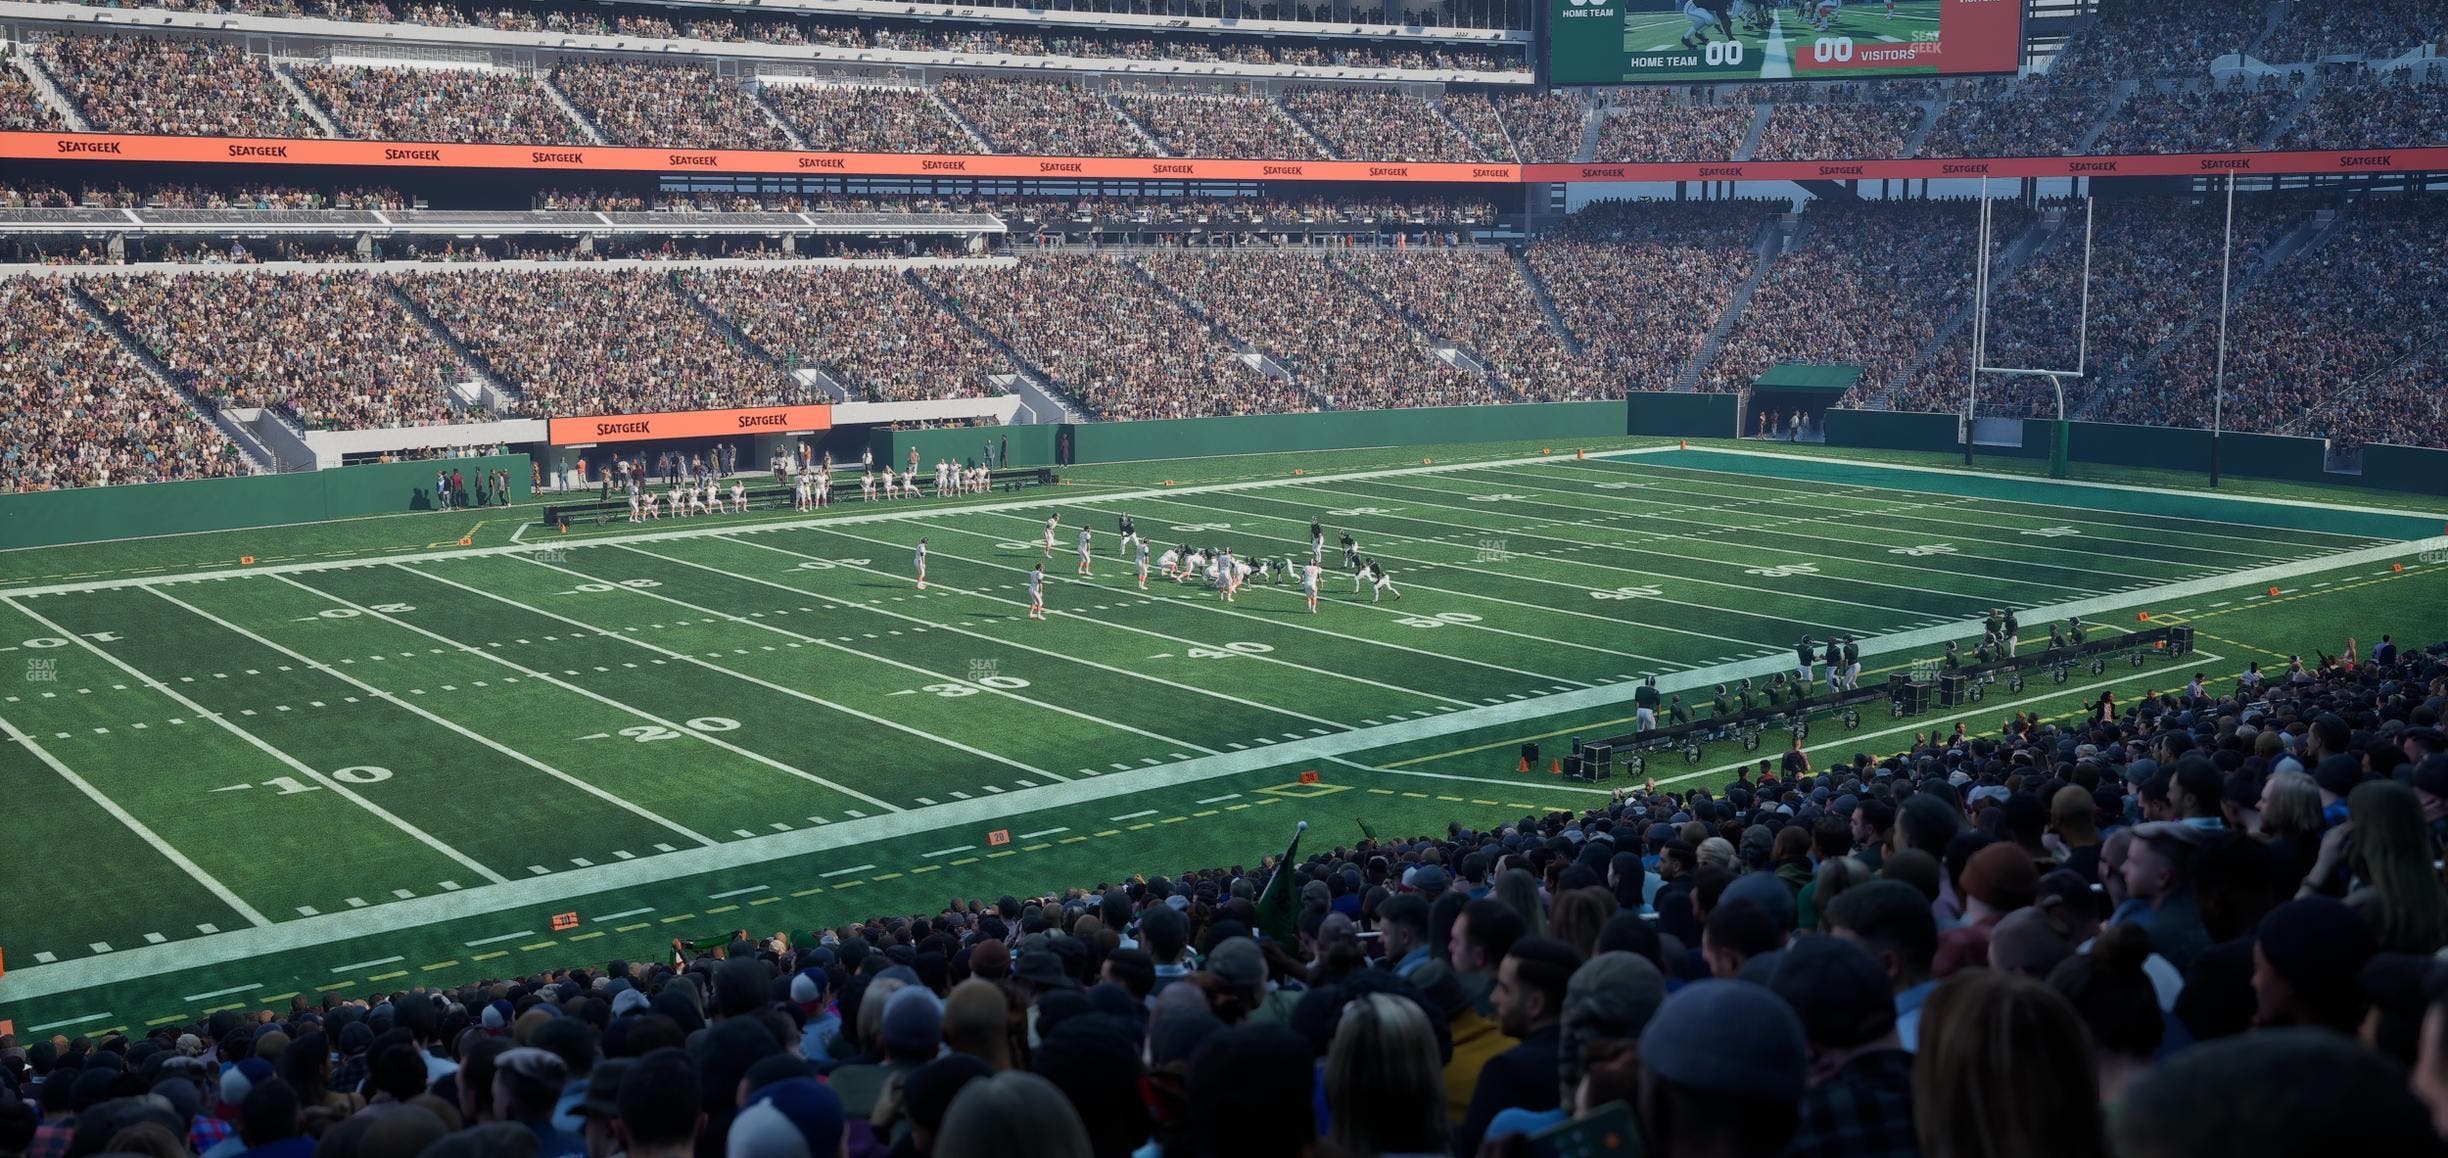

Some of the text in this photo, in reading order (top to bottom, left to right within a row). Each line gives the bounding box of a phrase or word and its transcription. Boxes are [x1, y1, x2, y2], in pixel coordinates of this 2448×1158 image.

[1562, 8, 1614, 18] HOME TEAM
[1705, 40, 1744, 66] 00
[1814, 37, 1853, 63] 00
[1860, 49, 1916, 62] VISITORS
[1631, 56, 1698, 68] HOME TEAM
[58, 140, 121, 154] SEATGEEK
[228, 144, 288, 158] SEATGEEK
[385, 148, 441, 161] SEATGEEK
[532, 152, 584, 164] SEATGEEK
[669, 154, 718, 167] SEATGEEK
[798, 157, 845, 169] SEATGEEK
[922, 160, 966, 171] SEATGEEK
[1040, 162, 1082, 173] SEATGEEK
[2068, 161, 2117, 173] SEATGEEK
[2200, 158, 2251, 172] SEATGEEK
[2340, 155, 2392, 169] SEATGEEK
[1152, 164, 1194, 174] SEATGEEK
[1263, 165, 1303, 176] SEATGEEK
[1369, 166, 1408, 177] SEATGEEK
[1473, 167, 1511, 178] SEATGEEK
[1582, 168, 1625, 178] SEATGEEK
[1698, 167, 1743, 177] SEATGEEK
[1818, 165, 1864, 176] SEATGEEK
[1942, 163, 1989, 175] SEATGEEK
[597, 413, 788, 436] SEATGEEK SEATGEEK
[1744, 564, 1821, 577] 30
[575, 577, 663, 592] 30
[1589, 587, 1664, 600] 40
[319, 602, 417, 619] 20
[1392, 612, 1483, 629] 50
[1187, 641, 1275, 660] 40
[921, 676, 1031, 698] 30
[618, 716, 742, 743] 20
[259, 765, 394, 796] 10
[993, 832, 1005, 842] 20
